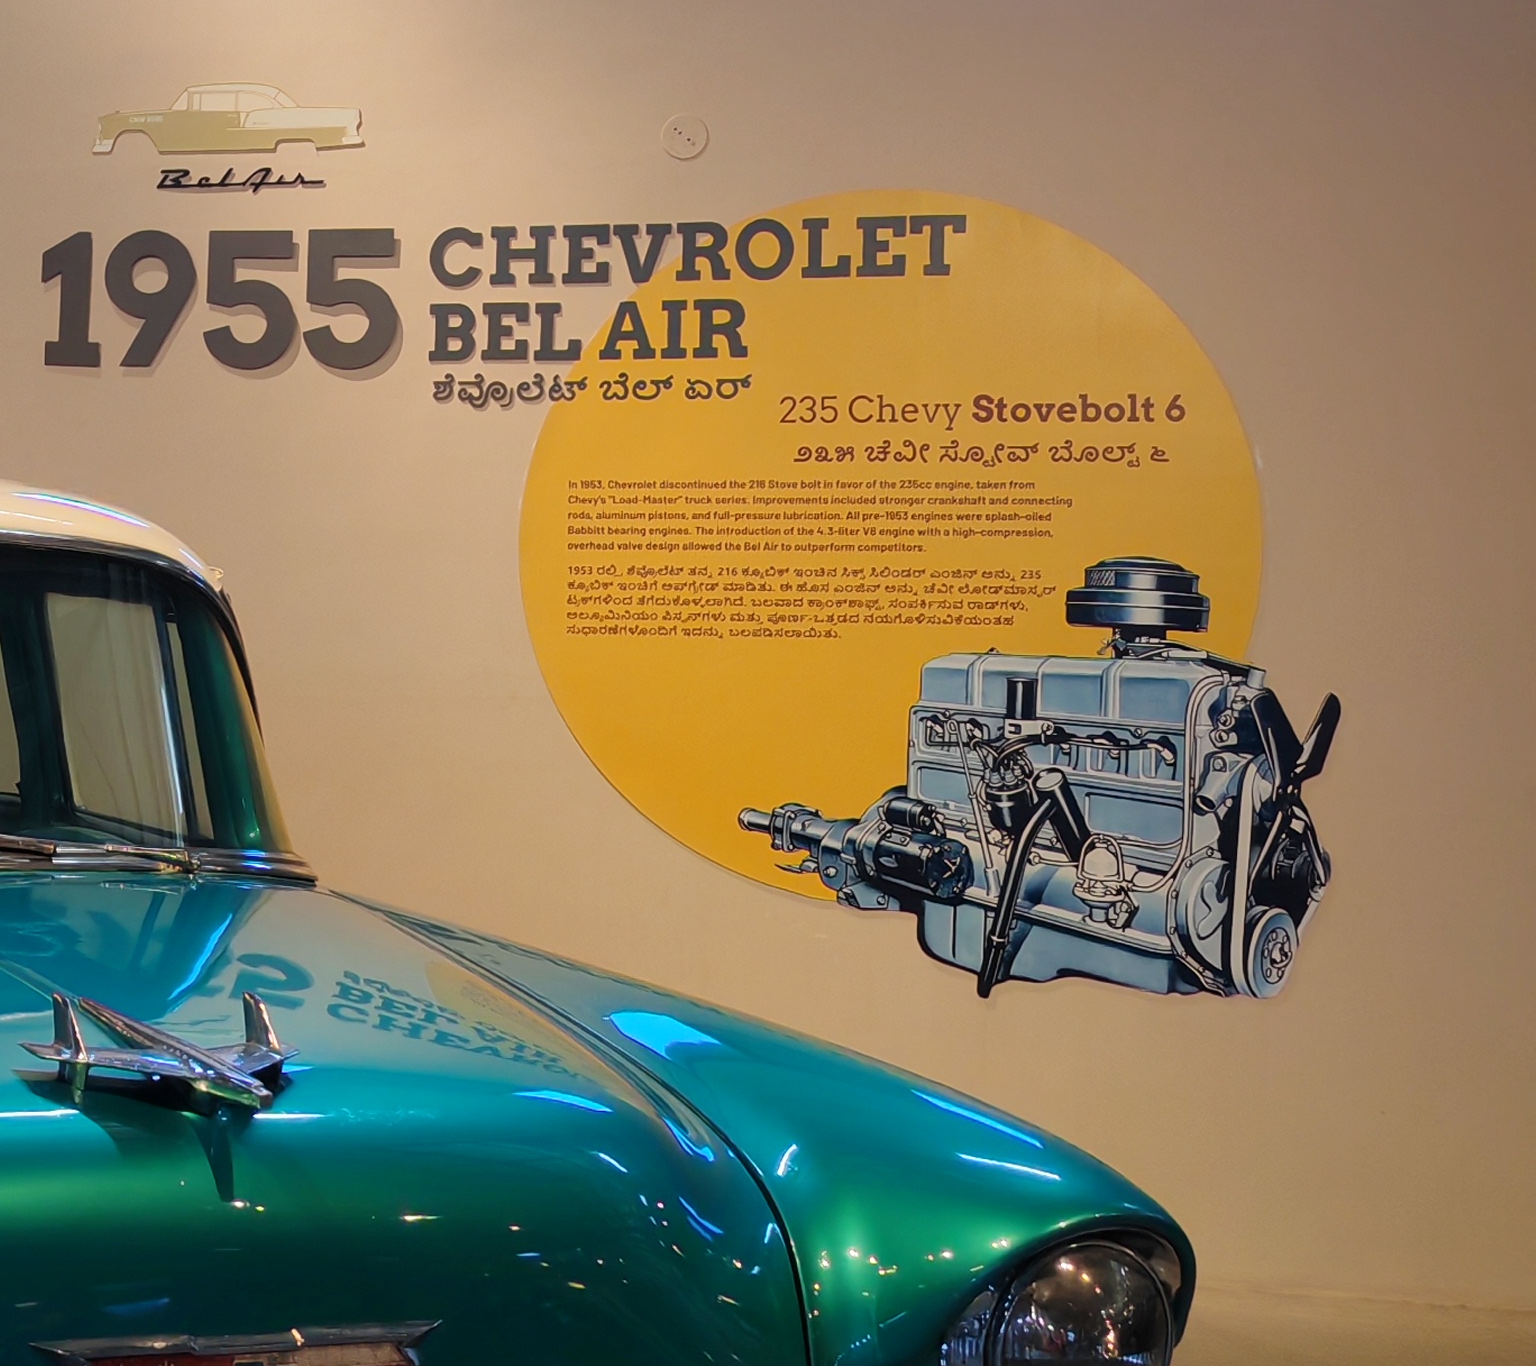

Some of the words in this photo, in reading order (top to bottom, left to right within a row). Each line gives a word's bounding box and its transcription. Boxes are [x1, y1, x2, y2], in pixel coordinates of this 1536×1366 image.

[428, 214, 967, 288] CHEVROLET
[40, 227, 401, 371] 1955
[427, 301, 583, 362] BEL
[598, 297, 749, 361] AIR
[433, 373, 588, 411] ಶೆವ್ರೊಲೆಟ್
[599, 372, 673, 400] ಬೆಲ್
[685, 374, 752, 399] ಏರ್
[780, 396, 838, 423] 235
[849, 395, 962, 431] Chevy
[972, 394, 1154, 423] Stovebolt
[1165, 394, 1185, 422] 6
[864, 440, 930, 463] ಚೆವೀ
[940, 440, 1039, 467] ಸ್ಟೋವ್
[1049, 440, 1140, 467] ಬೊಲ್ಟ್
[568, 479, 578, 491] In
[579, 479, 606, 490] 1953,
[607, 479, 658, 490] Chevrolet
[658, 479, 727, 490] discontinued
[728, 479, 747, 490] the
[747, 479, 767, 490] 216
[767, 479, 799, 490] Stove
[799, 479, 822, 490] bolt
[822, 479, 834, 490] in
[835, 479, 865, 490] favor
[865, 479, 878, 490] of
[878, 479, 898, 490] the
[934, 479, 974, 492] engine,
[975, 479, 1007, 490] taken
[1008, 479, 1036, 491] from
[567, 494, 607, 507] Chevy's
[607, 494, 684, 506] "Load-Master"
[684, 494, 713, 505] truck
[714, 495, 750, 505] series.
[752, 494, 829, 507] Improvements
[829, 494, 877, 506] included
[878, 495, 927, 508] stronger
[927, 495, 987, 506] crankshaft
[988, 495, 1009, 506] and
[1010, 495, 1073, 509] connecting
[567, 510, 594, 521] rods,
[595, 509, 647, 520] aluminum
[647, 509, 690, 522] pistons,
[691, 510, 712, 520] and
[712, 510, 782, 523] full-pressure
[782, 510, 845, 521] lubrication.
[845, 510, 861, 521] All
[910, 510, 954, 524] engines
[955, 513, 984, 522] were
[984, 511, 1052, 524] splash-oiled
[567, 525, 606, 536] Babbitt
[606, 525, 647, 538] bearing
[648, 525, 693, 538] engines.
[694, 525, 715, 536] The
[715, 525, 782, 537] introduction
[782, 526, 795, 536] of
[796, 526, 815, 537] the
[816, 526, 861, 537] 4.3-liter
[878, 526, 916, 539] engine
[916, 526, 942, 537] with
[942, 528, 951, 537] a
[952, 526, 1054, 540] high-compression,
[567, 540, 615, 551] overhead
[616, 540, 644, 551] valve
[644, 540, 680, 554] design
[681, 541, 723, 552] allowed
[724, 541, 742, 552] the
[743, 541, 761, 552] Bel
[762, 541, 780, 552] Air
[780, 542, 793, 552] to
[793, 542, 856, 554] outperform
[857, 542, 927, 554] competitors.
[567, 565, 593, 576] 1953
[717, 566, 739, 577] 216
[1019, 569, 1042, 580] 235
